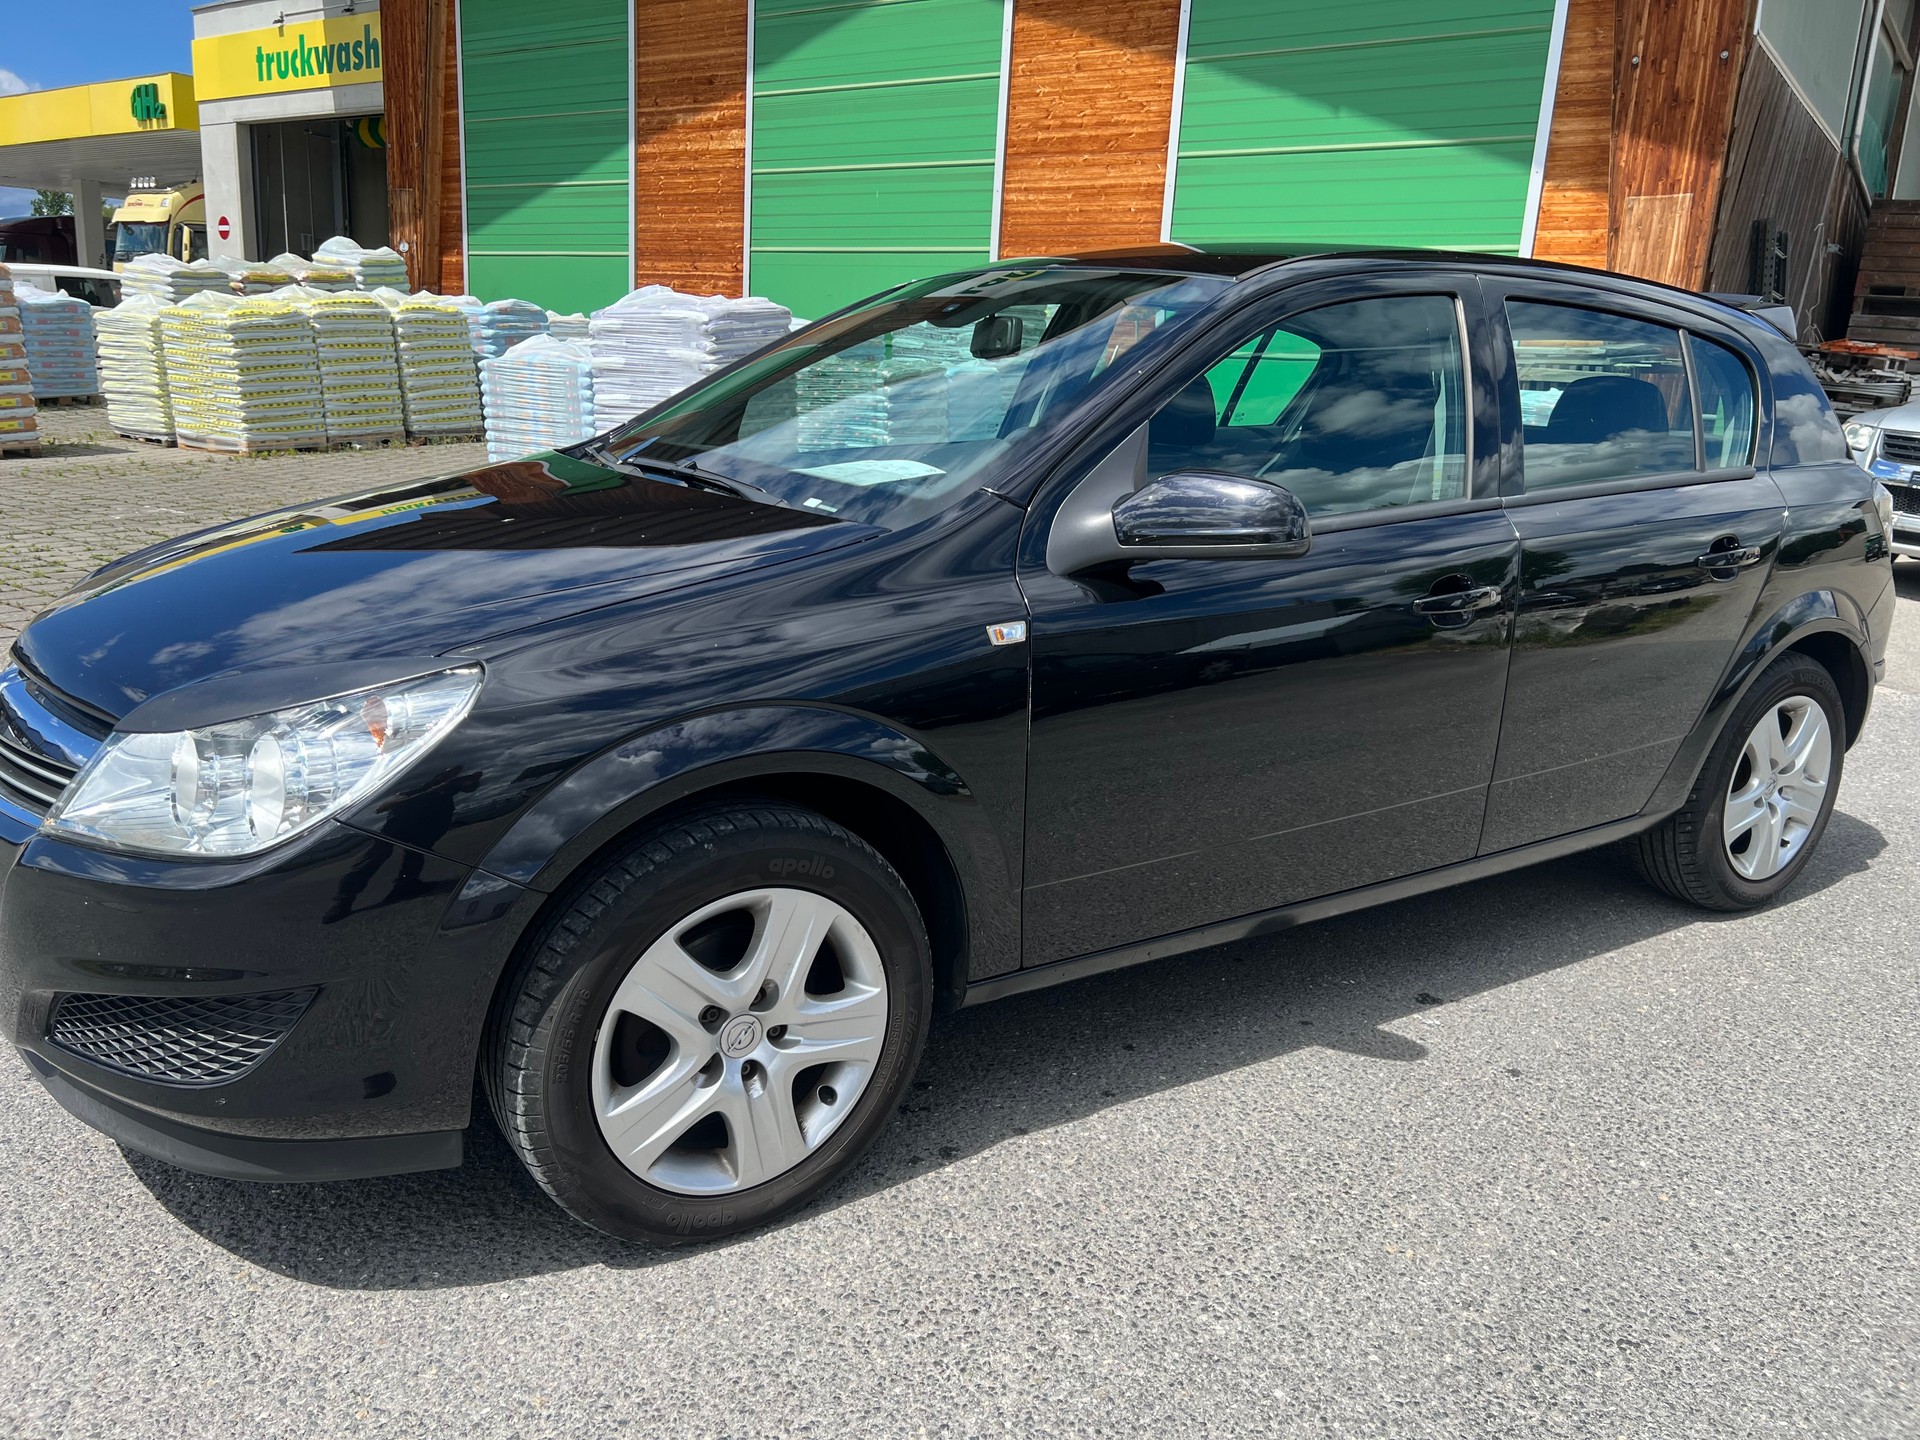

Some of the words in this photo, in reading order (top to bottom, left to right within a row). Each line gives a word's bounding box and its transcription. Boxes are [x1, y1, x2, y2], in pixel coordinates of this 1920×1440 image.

[256, 24, 380, 81] truckwash
[768, 855, 836, 879] apollo
[666, 1206, 736, 1234] apollo
